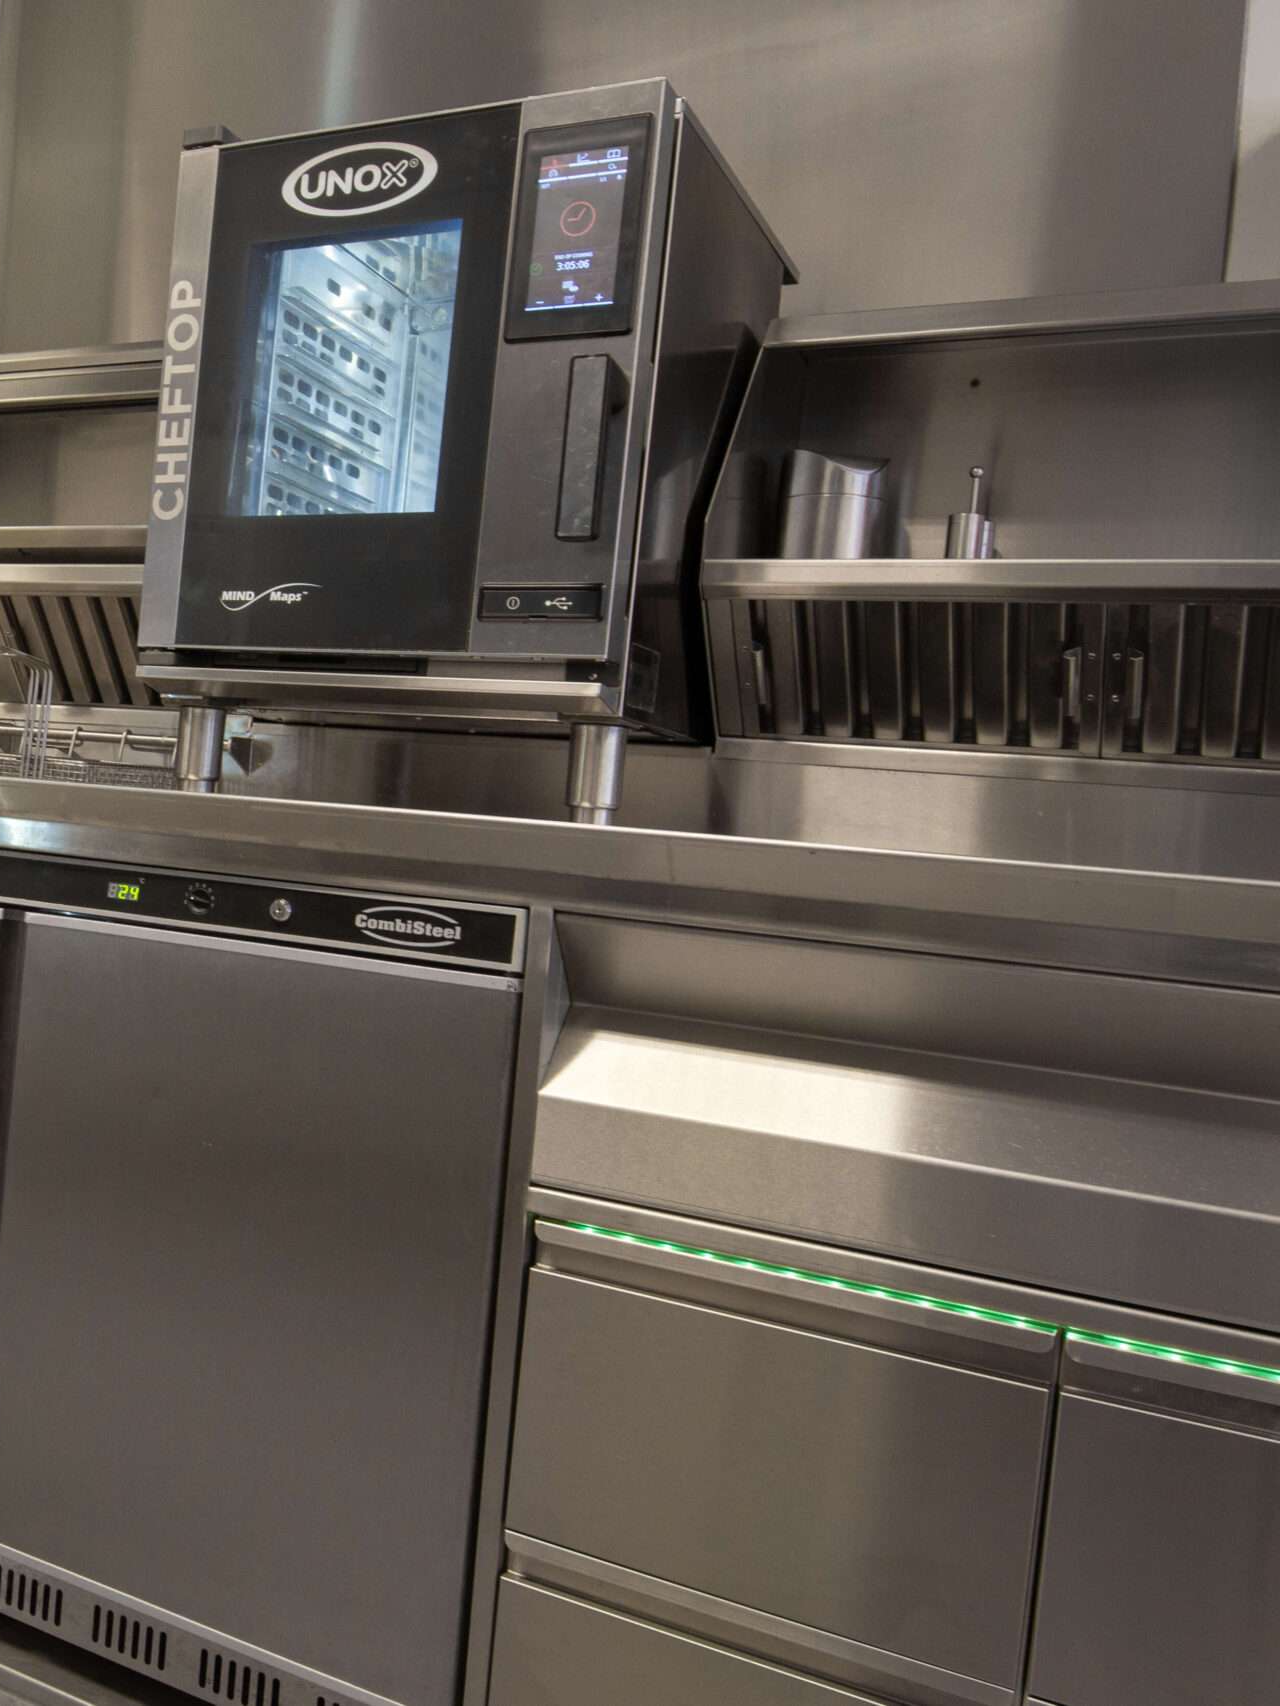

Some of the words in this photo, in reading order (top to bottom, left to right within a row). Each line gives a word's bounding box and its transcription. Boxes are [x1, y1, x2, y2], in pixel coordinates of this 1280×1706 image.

[300, 159, 409, 200] UNOX
[152, 279, 202, 520] CHEFTOP
[221, 590, 255, 601] MIND
[269, 590, 302, 604] Maps
[117, 883, 140, 901] 24
[354, 913, 462, 940] CombiSteel
